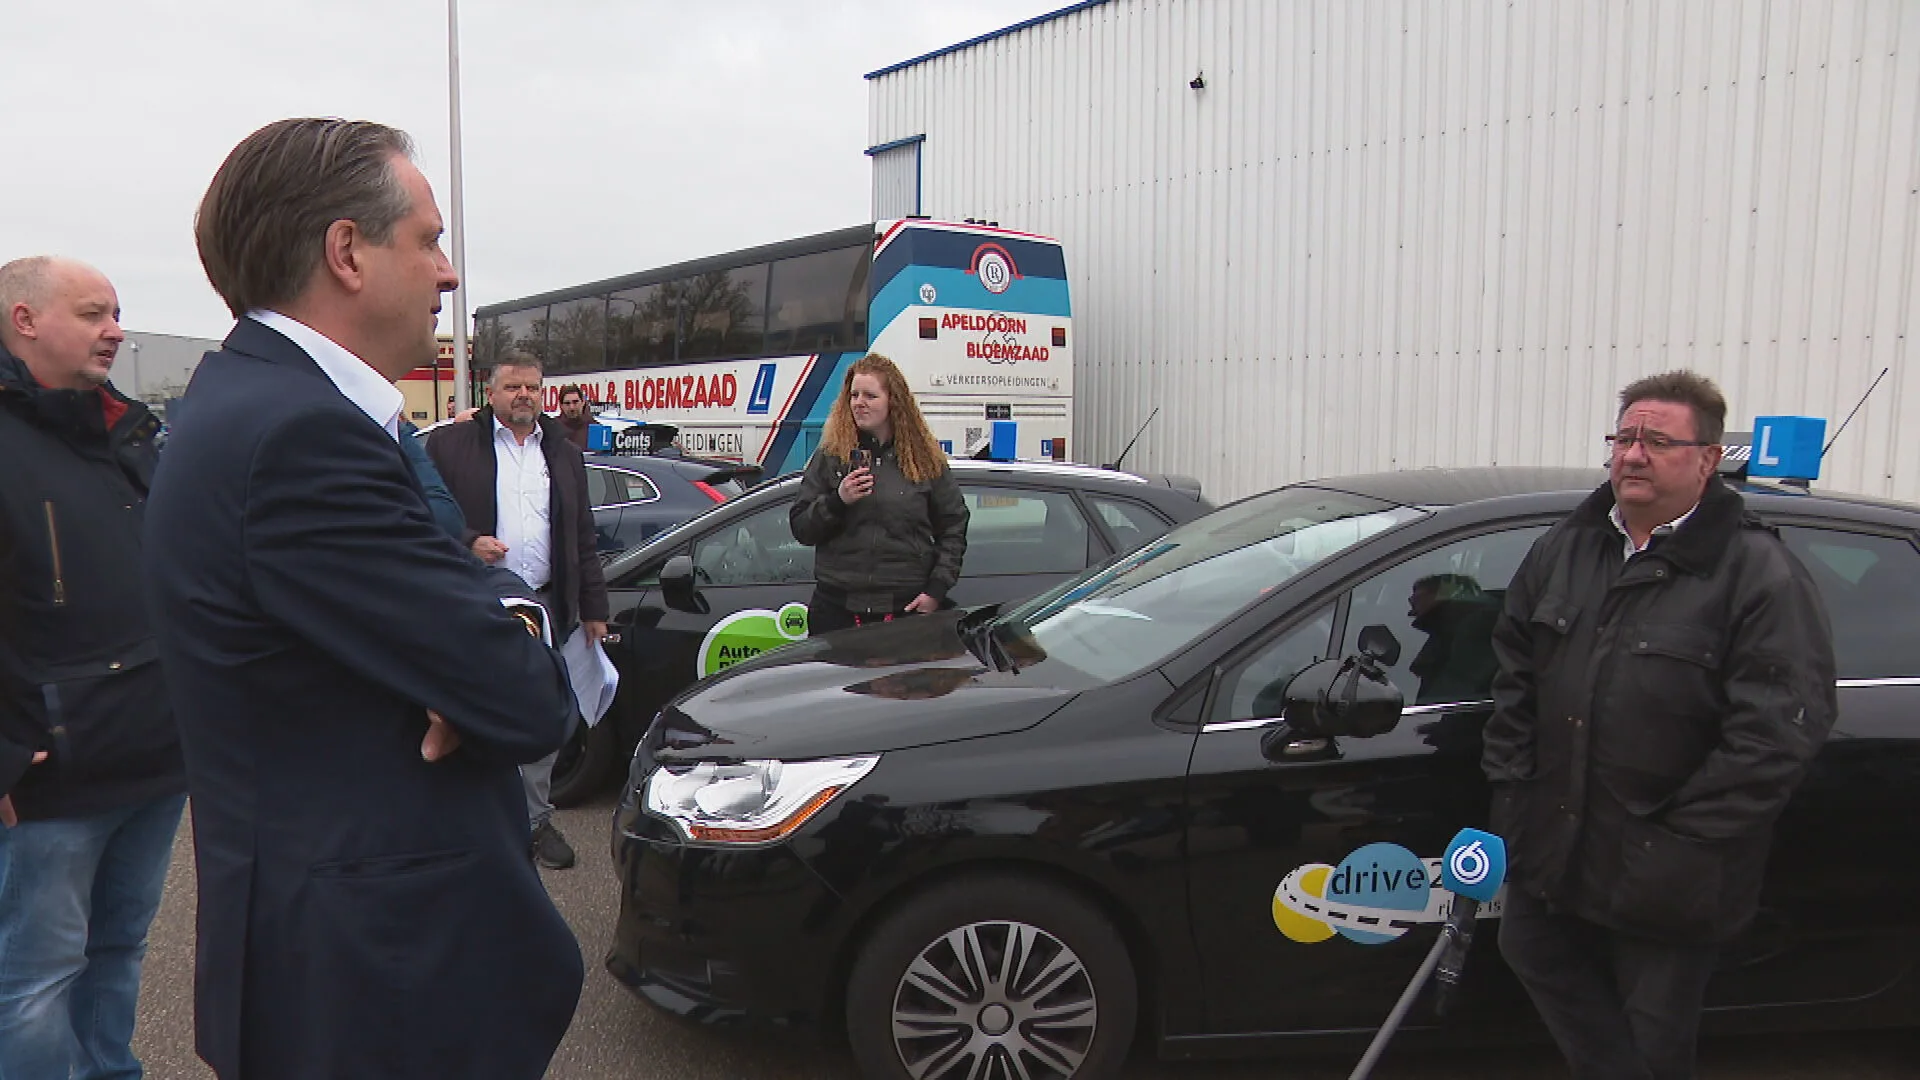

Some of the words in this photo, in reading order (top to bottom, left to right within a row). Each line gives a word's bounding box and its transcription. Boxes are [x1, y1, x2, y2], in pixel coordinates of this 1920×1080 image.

[941, 313, 1027, 335] APELDOORN
[966, 341, 1049, 361] BLOEMZAAD
[606, 381, 618, 404] &
[625, 373, 737, 410] BLOEMZAAD
[754, 371, 768, 406] L
[946, 374, 1047, 388] VERKEERSOPLEIDINGEN
[602, 429, 609, 447] L
[615, 432, 651, 449] Cents
[1757, 425, 1780, 465] L
